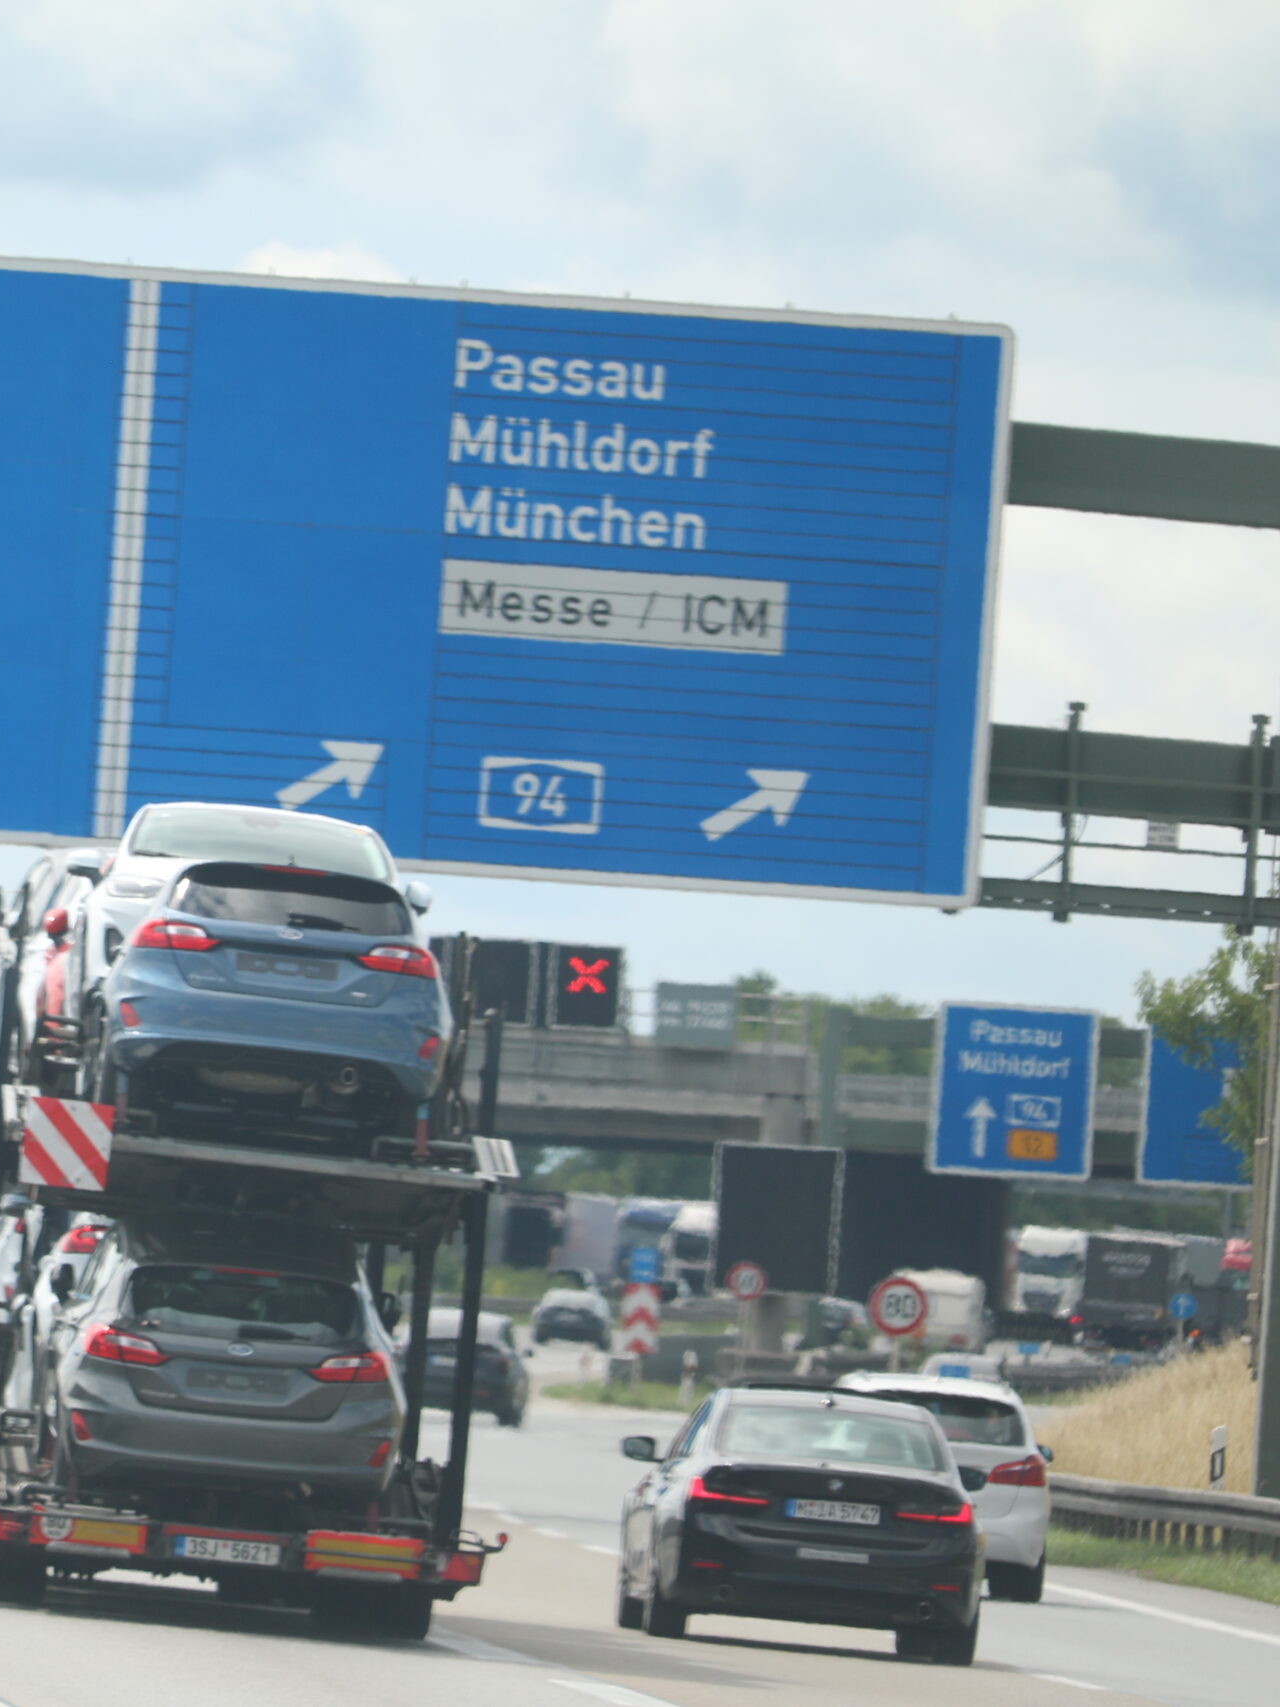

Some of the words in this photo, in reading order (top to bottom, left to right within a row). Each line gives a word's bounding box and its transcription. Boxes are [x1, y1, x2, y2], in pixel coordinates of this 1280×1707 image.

[453, 338, 666, 401] Passau
[448, 412, 716, 479] Mühldorf
[443, 482, 708, 551] München
[457, 578, 612, 627] Messe
[637, 592, 657, 630] /
[681, 592, 770, 639] ICM
[512, 772, 568, 818] 94
[971, 1020, 1063, 1048] Passau
[959, 1050, 1072, 1079] Mühldorf
[885, 1293, 917, 1320] 80
